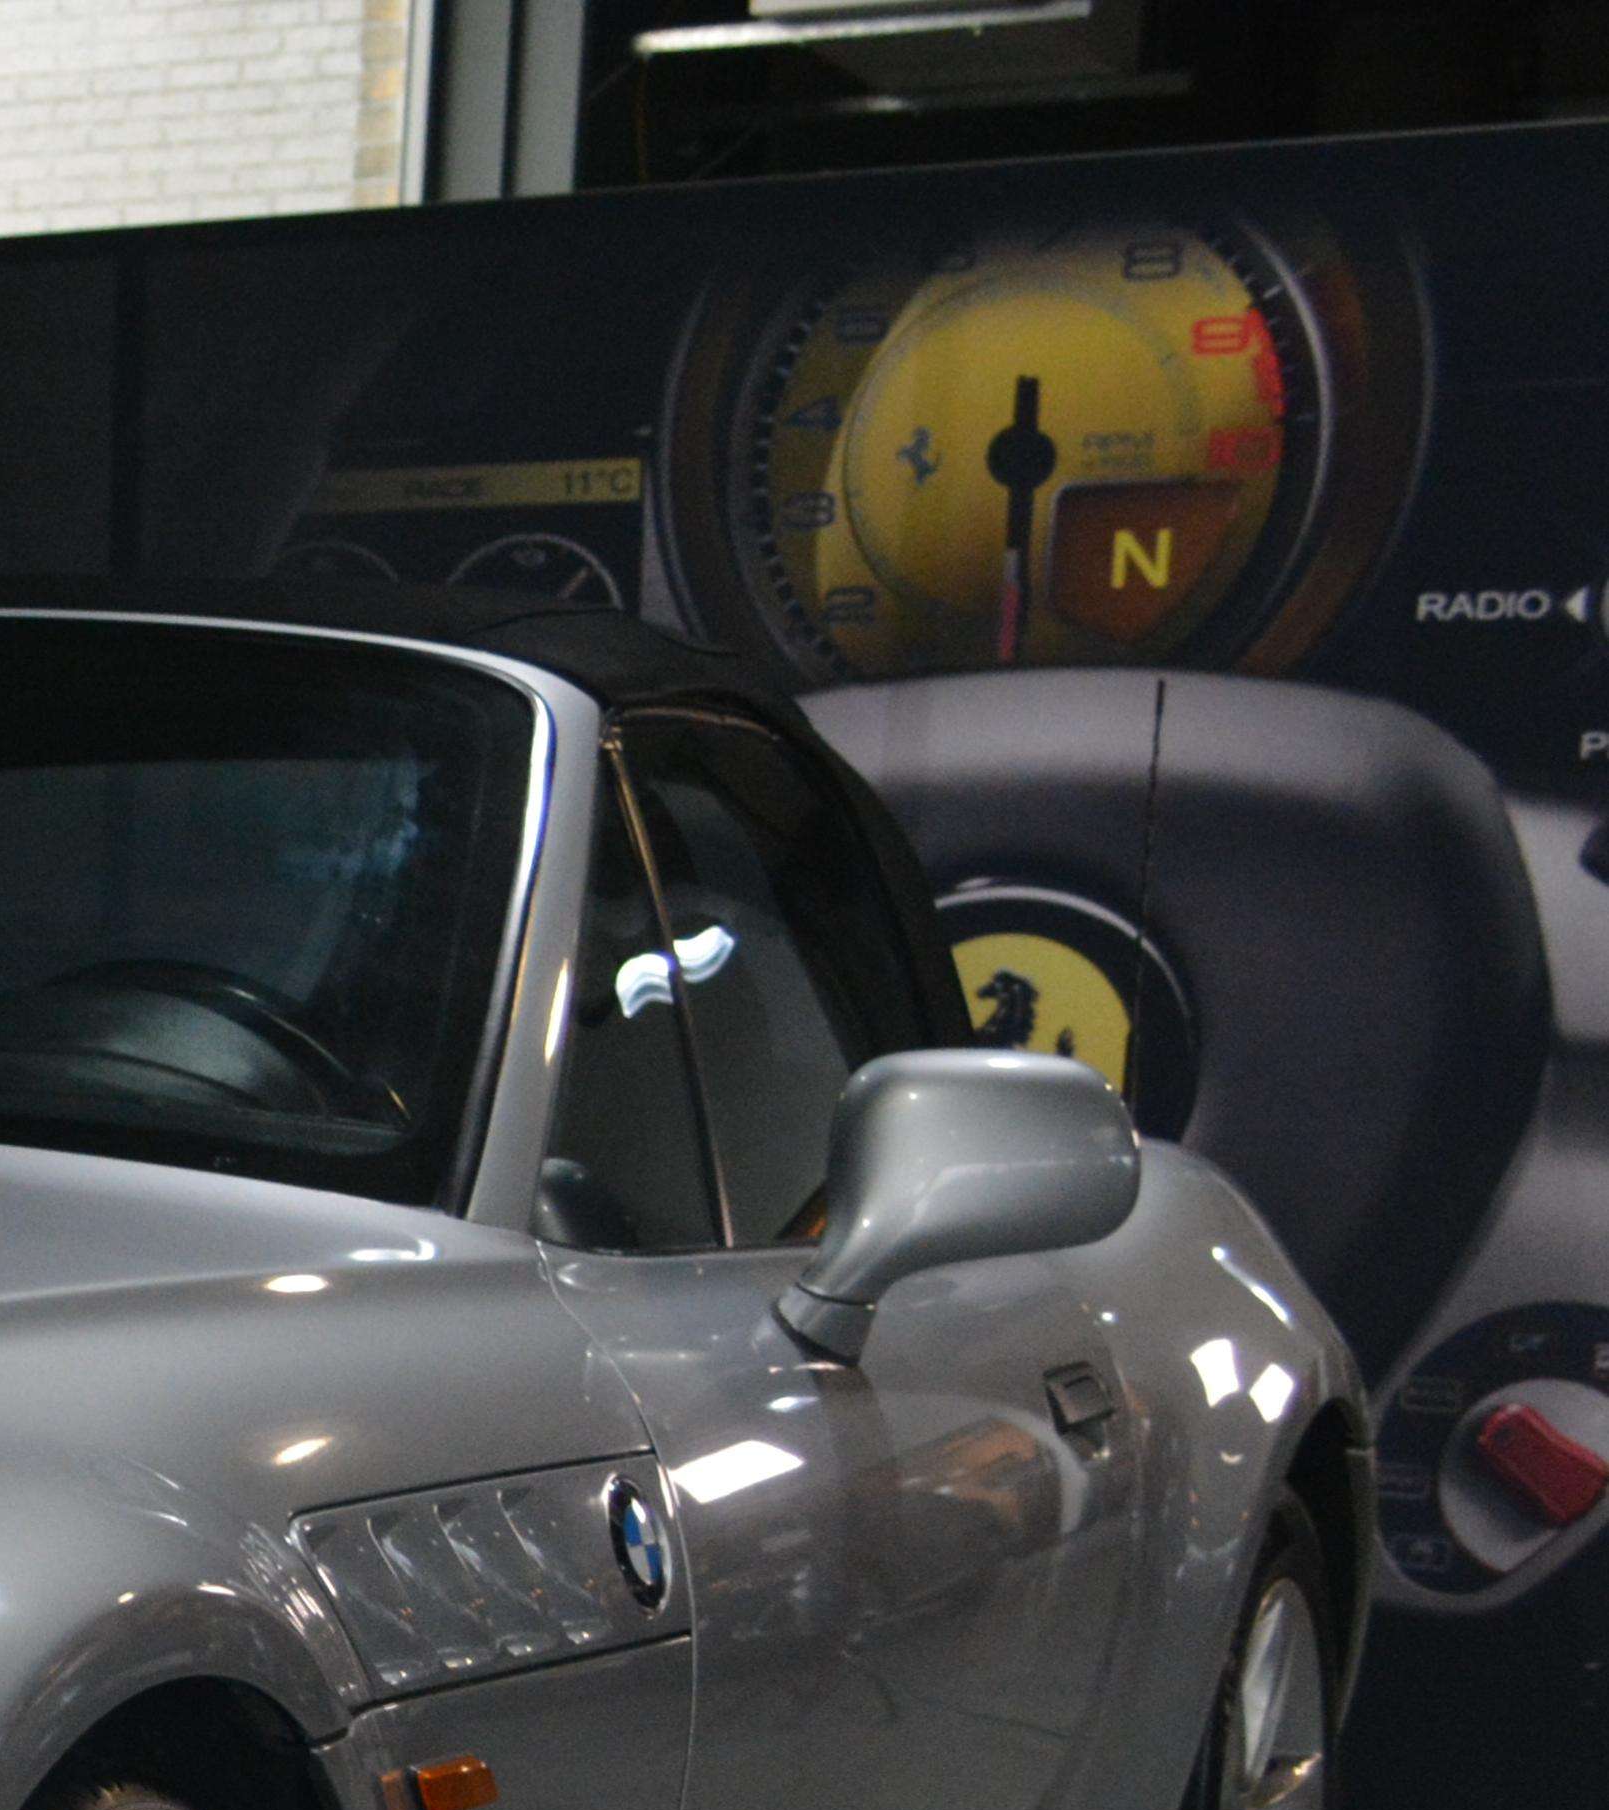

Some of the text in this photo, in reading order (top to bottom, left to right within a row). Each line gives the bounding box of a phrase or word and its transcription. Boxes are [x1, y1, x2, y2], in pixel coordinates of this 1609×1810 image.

[1122, 240, 1182, 281] 8
[786, 396, 843, 432] 4
[781, 493, 837, 531] 3
[1108, 527, 1174, 591] N
[1415, 588, 1552, 622] RADIO
